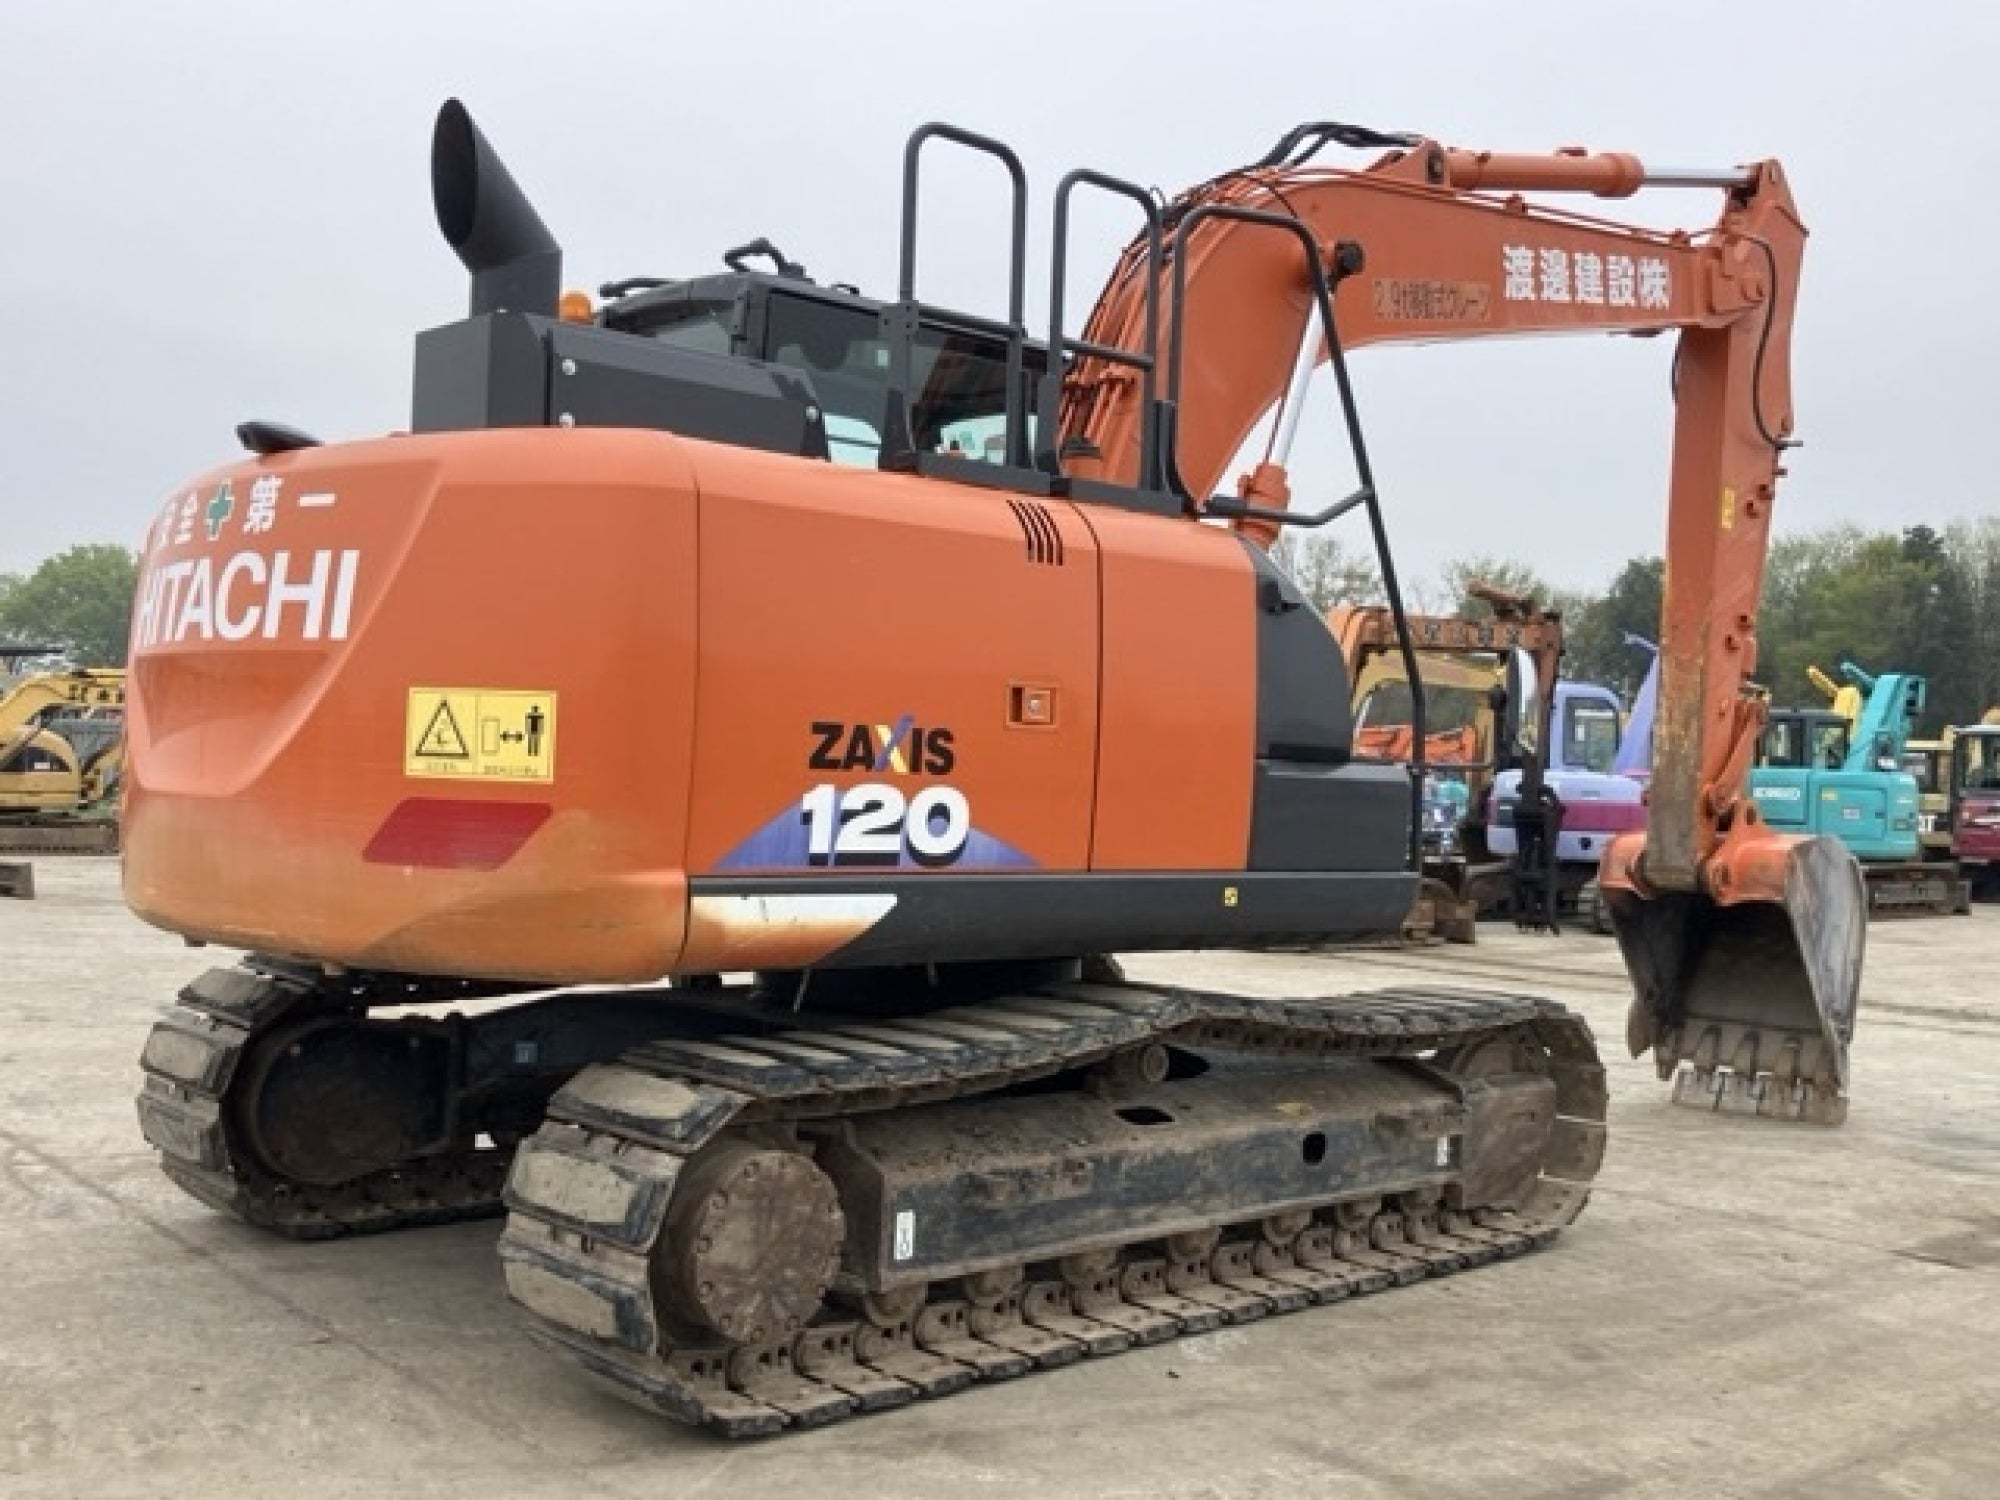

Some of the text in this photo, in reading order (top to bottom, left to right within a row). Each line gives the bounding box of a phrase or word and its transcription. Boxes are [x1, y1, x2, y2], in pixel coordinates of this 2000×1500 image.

[138, 549, 360, 646] HITACHI
[808, 714, 955, 775] ZAXIS
[801, 783, 970, 866] 120
